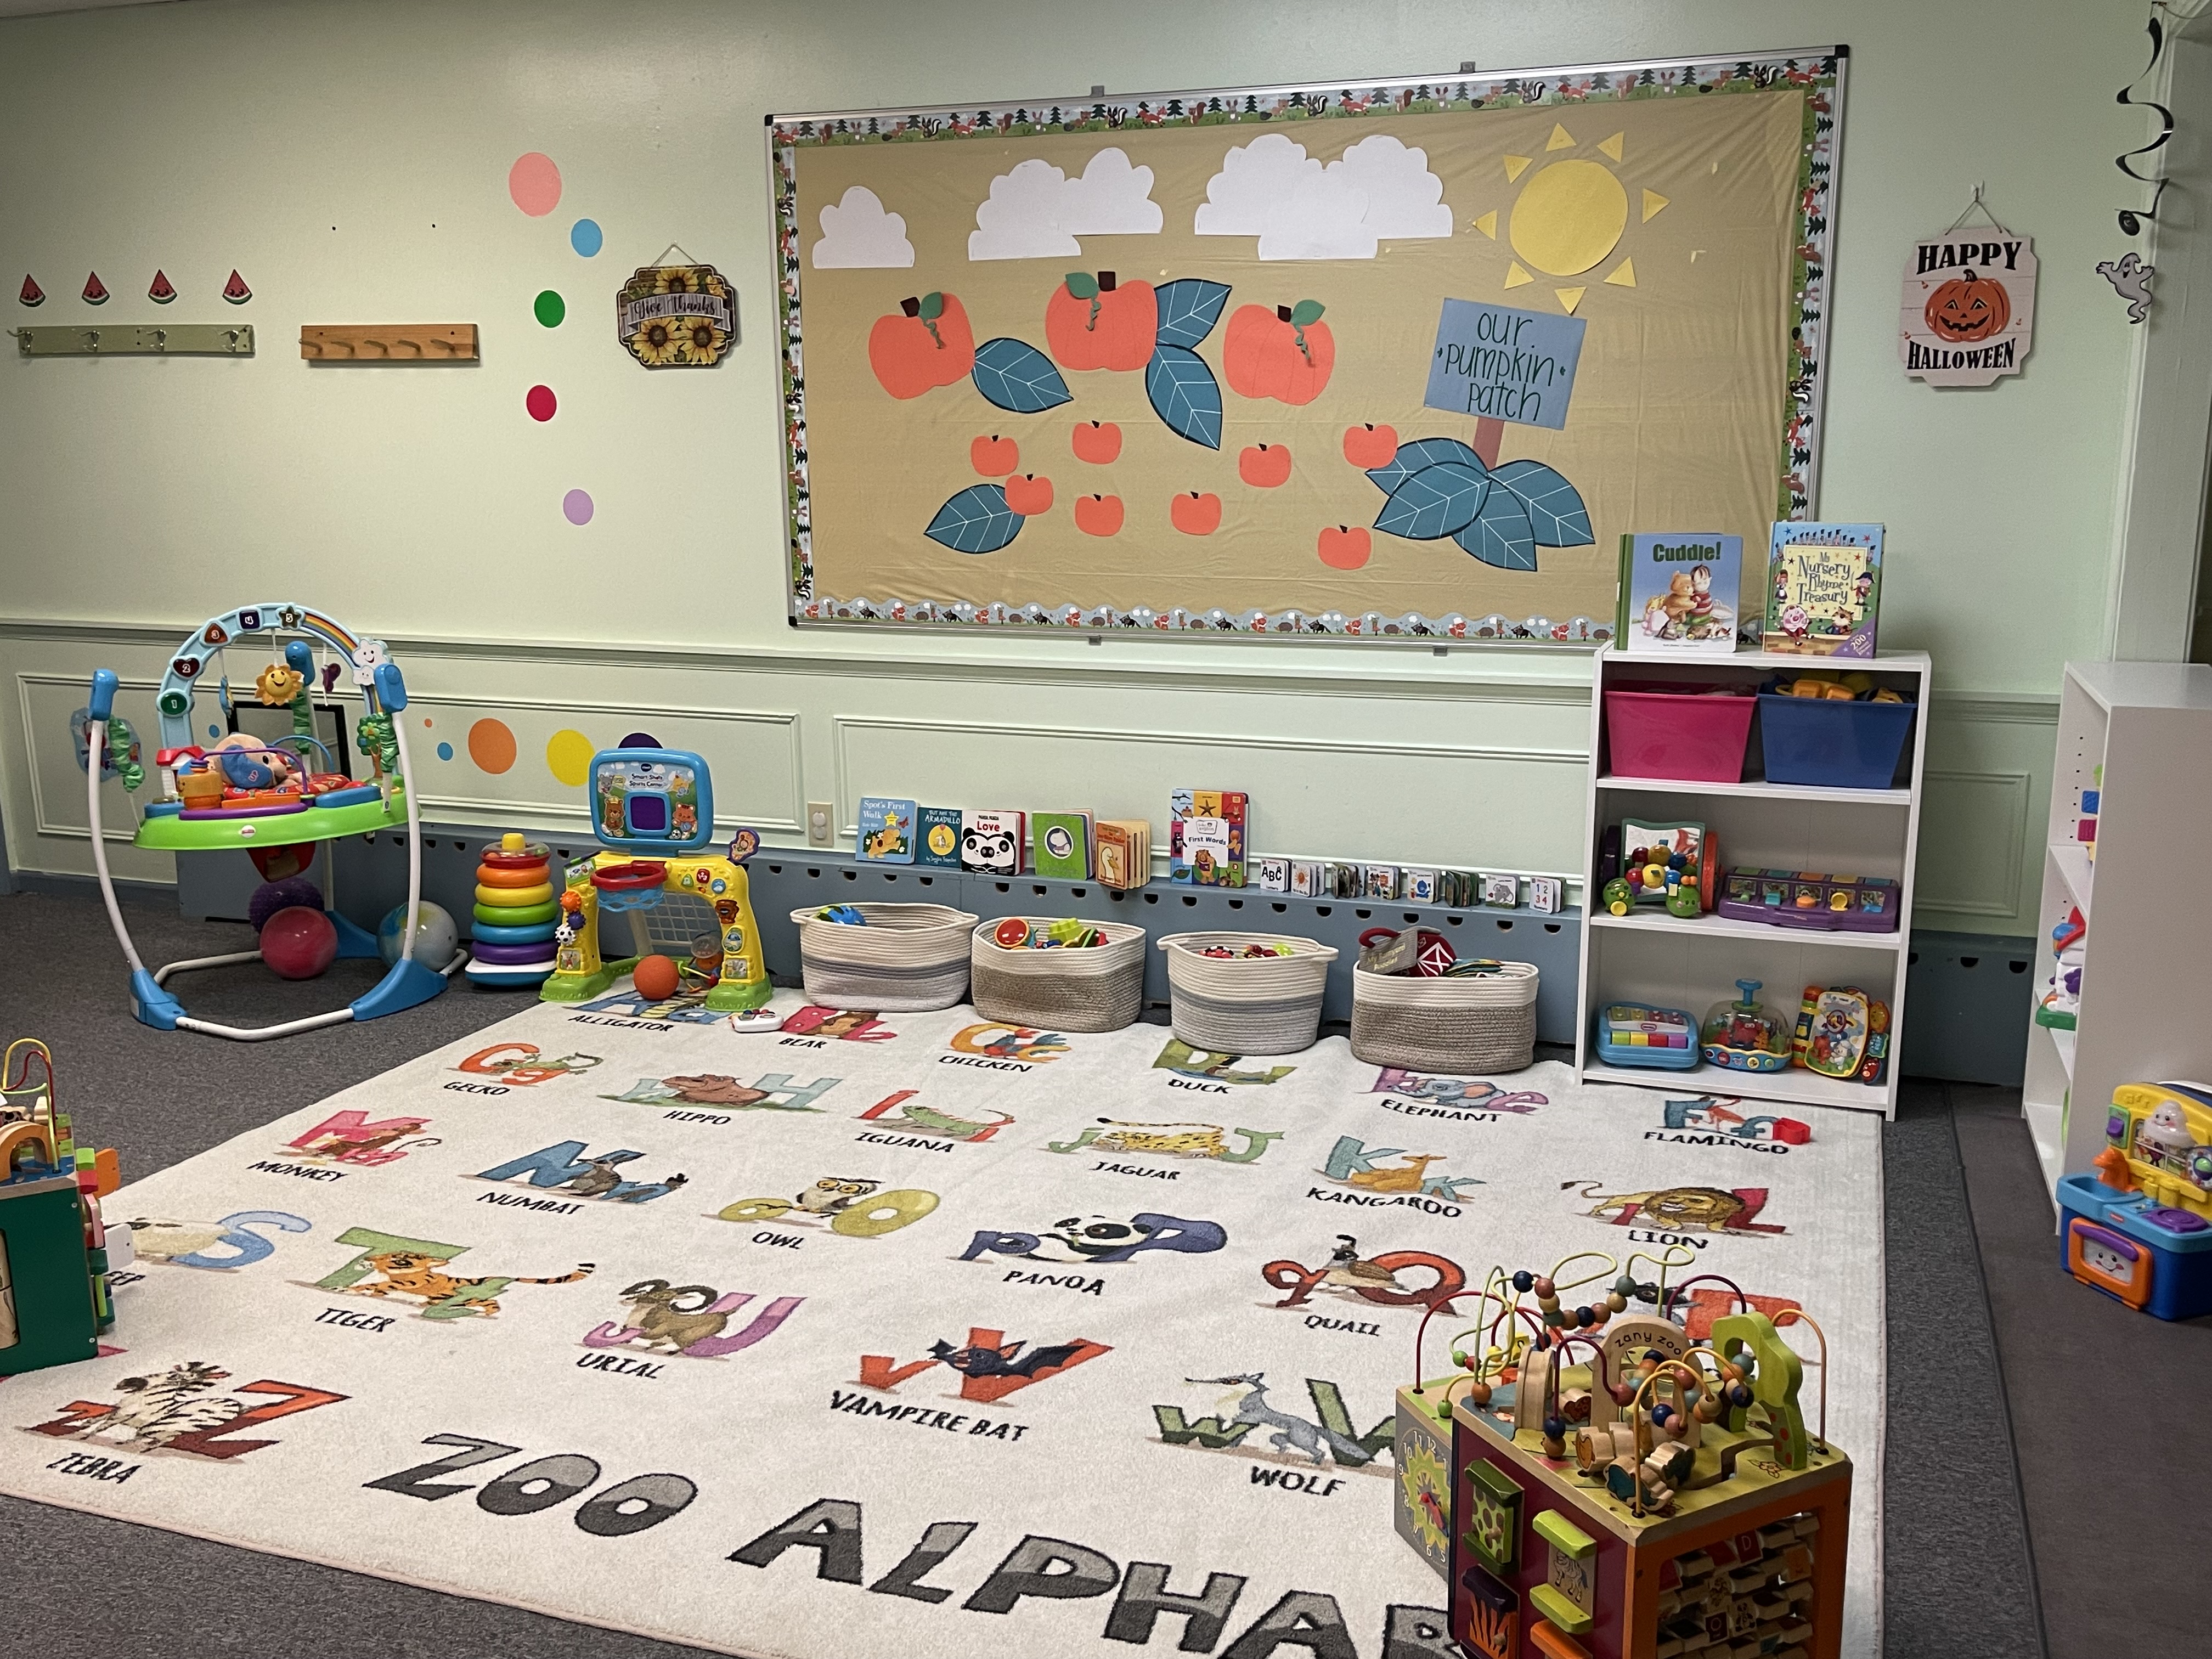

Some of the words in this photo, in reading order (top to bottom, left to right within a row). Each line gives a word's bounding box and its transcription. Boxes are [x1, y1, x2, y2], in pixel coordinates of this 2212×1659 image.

[1916, 242, 2023, 275] HAPPY
[1477, 312, 1533, 346] our
[1907, 338, 2016, 369] HALLOWEEN
[1653, 541, 1721, 562] Cuddle!
[1797, 555, 1850, 580] Nursery
[1808, 573, 1843, 592] Rhyme
[1797, 583, 1848, 605] Treasury
[245, 616, 254, 625] 4
[285, 613, 294, 623] 5
[1850, 634, 1866, 651] 200
[182, 663, 191, 673] 2
[171, 699, 177, 708] 1
[863, 800, 885, 809] Spot's
[887, 802, 905, 810] First
[863, 810, 882, 819] Walk
[925, 814, 961, 824] ARMADILLO
[977, 821, 1000, 831] Love
[1205, 837, 1226, 845] Words
[1262, 866, 1282, 882] ABC
[1536, 884, 1540, 893] 1
[1543, 885, 1548, 894] 2
[1542, 896, 1547, 905] 4
[568, 1014, 675, 1031] ALLIGATOR
[779, 1037, 828, 1049] BEAR
[938, 1056, 1032, 1073] CHICKEN
[444, 1082, 511, 1096] GECKO
[1168, 1078, 1233, 1094] DUCK
[664, 1110, 731, 1125] HIPPO
[1381, 1098, 1503, 1124] ELEPHANT
[1664, 1099, 1717, 1129] F
[855, 1132, 955, 1153] IGUANA
[1644, 1131, 1789, 1154] FLAMINGO
[1324, 1135, 1404, 1179] K
[247, 1161, 348, 1183] MONKEY
[1089, 1161, 1181, 1181] JAGUAR
[477, 1192, 585, 1217] NUMBAT
[1305, 1187, 1462, 1218] KANGAROO
[752, 1231, 806, 1251] OWL
[1628, 1228, 1710, 1250] LION
[1352, 1251, 1466, 1316] Q
[314, 1307, 396, 1333] TIGER
[1304, 1313, 1381, 1338] QUAIL
[1615, 1332, 1651, 1347] zany
[1657, 1336, 1682, 1355] zoo
[576, 1352, 668, 1379] URIAL
[829, 1389, 967, 1434] VAMPIRE
[969, 1417, 1030, 1444] BAT
[1413, 1431, 1422, 1447] 11
[1427, 1436, 1436, 1454] 12
[1403, 1443, 1412, 1459] 10
[47, 1452, 142, 1484] ZEBRA
[1398, 1464, 1403, 1476] 9
[362, 1432, 699, 1539] ZOO
[1249, 1465, 1346, 1498] WOLF
[1404, 1498, 1409, 1508] 8
[1426, 1545, 1431, 1557] 6
[1742, 1536, 1752, 1551] D
[1440, 1550, 1446, 1562] 5
